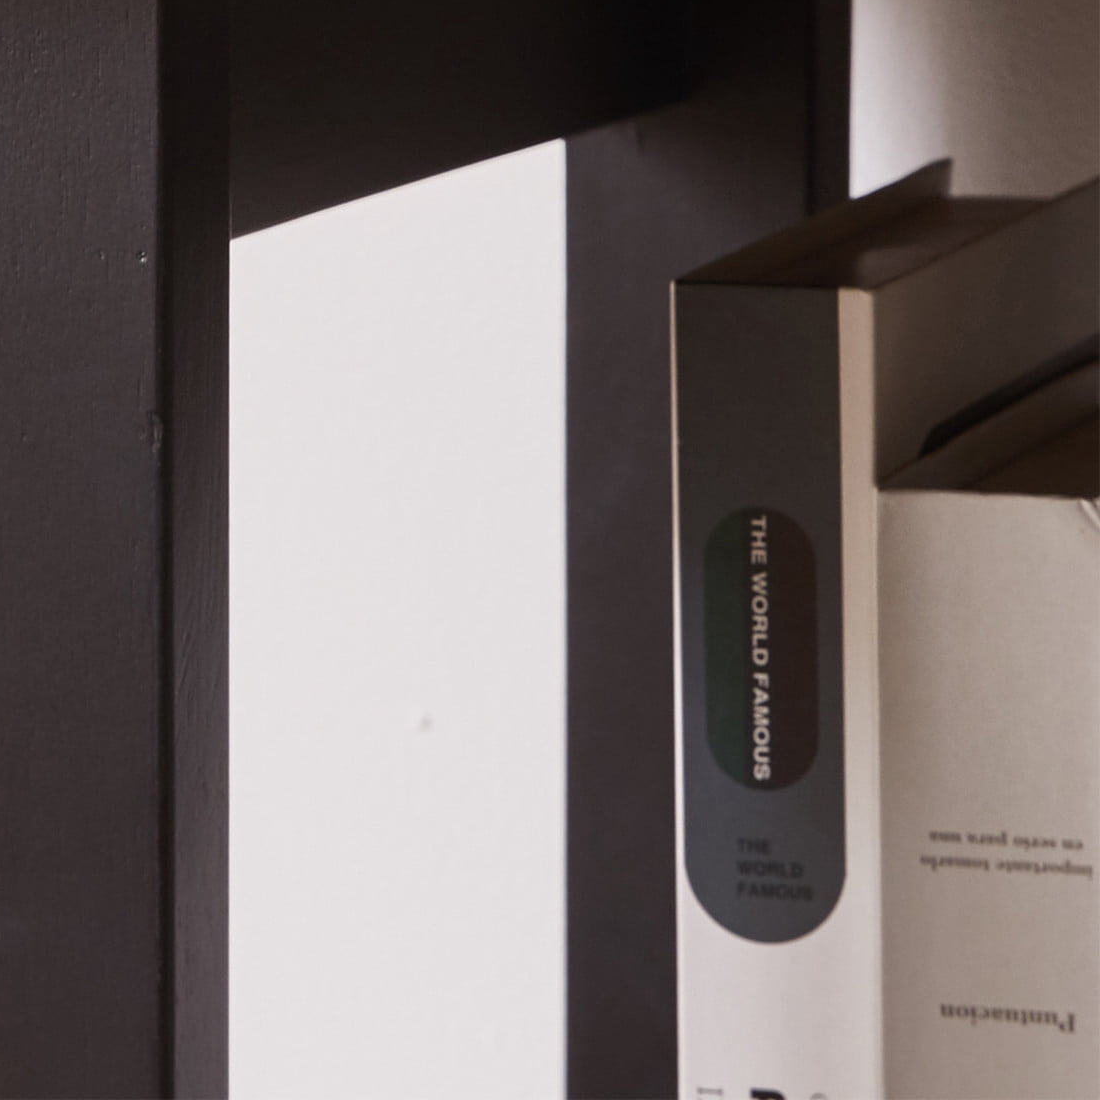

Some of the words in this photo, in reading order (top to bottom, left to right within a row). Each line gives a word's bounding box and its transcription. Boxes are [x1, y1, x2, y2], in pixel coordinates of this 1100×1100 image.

[750, 515, 767, 565] THE
[751, 571, 769, 666] WORLD
[752, 672, 771, 781] FAMOUS
[736, 837, 771, 855] THE
[736, 860, 804, 879] WORLD
[736, 881, 814, 902] FAMOUS
